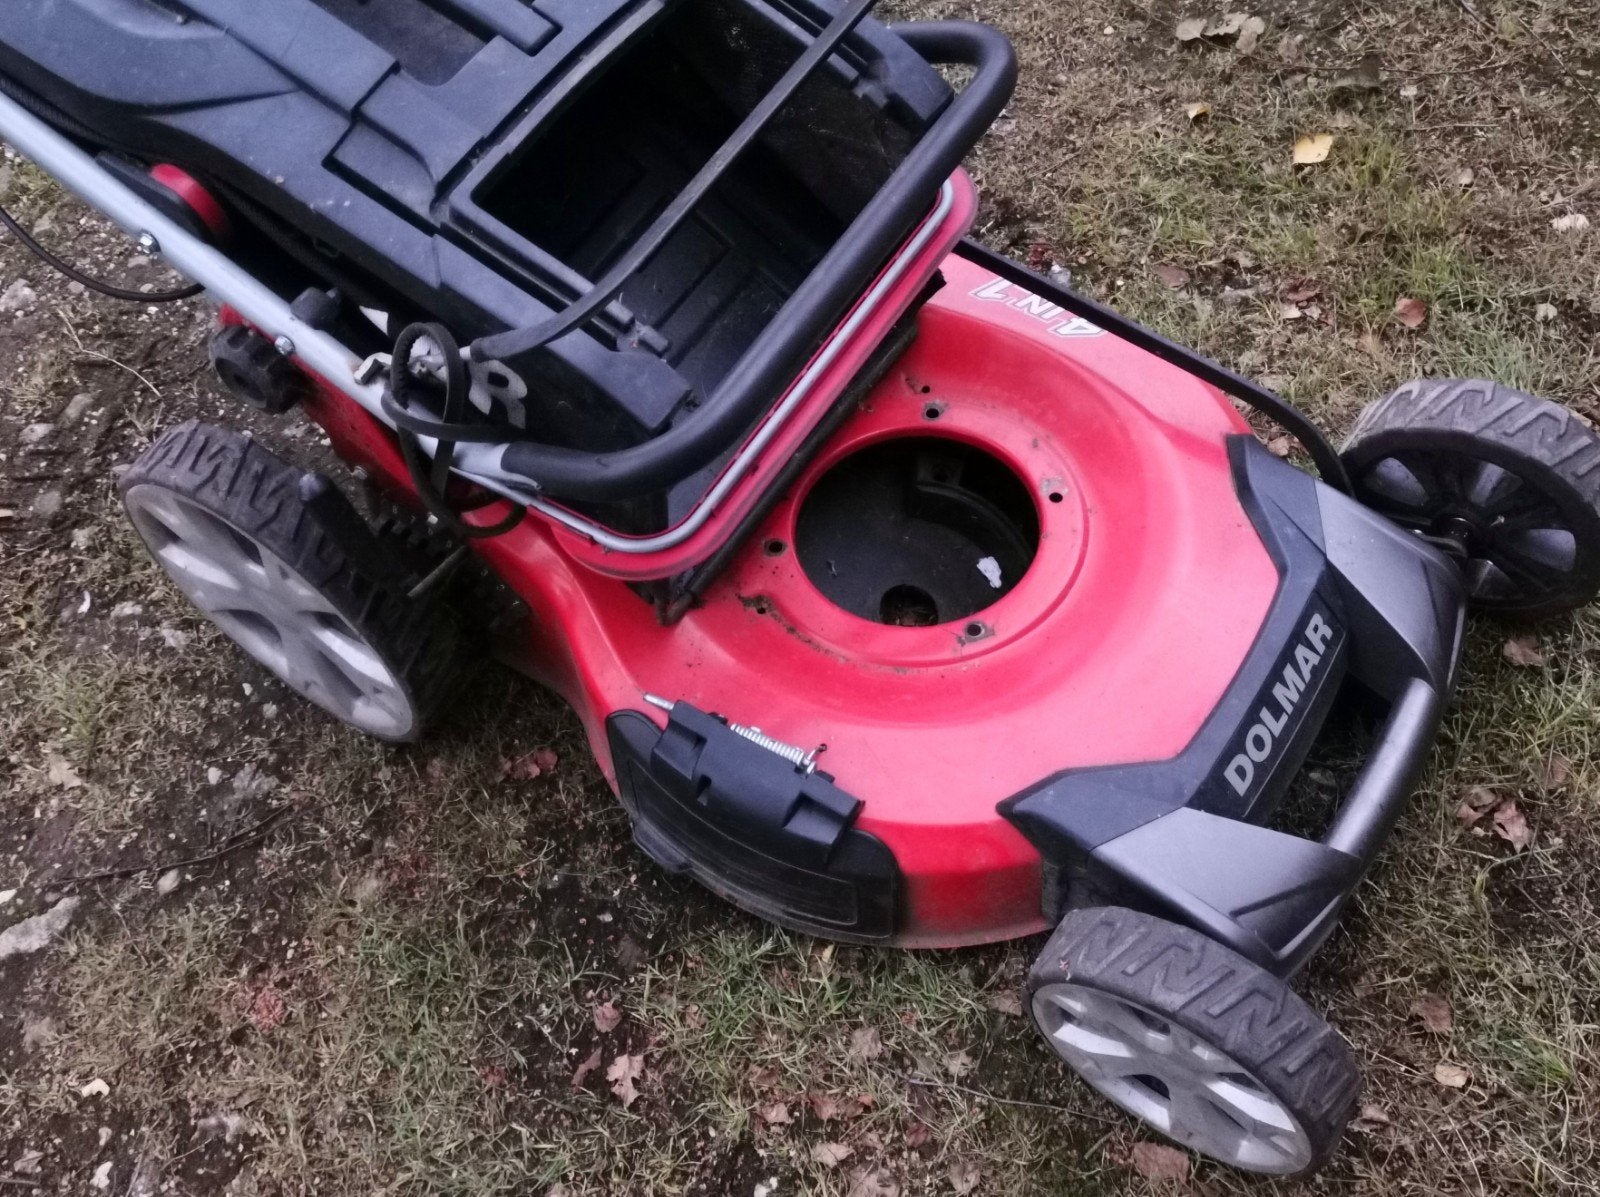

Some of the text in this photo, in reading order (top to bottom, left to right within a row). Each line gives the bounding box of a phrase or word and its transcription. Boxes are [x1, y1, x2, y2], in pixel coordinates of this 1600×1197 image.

[971, 277, 1106, 337] 4 IN 1
[1223, 613, 1333, 797] DOLMAR
